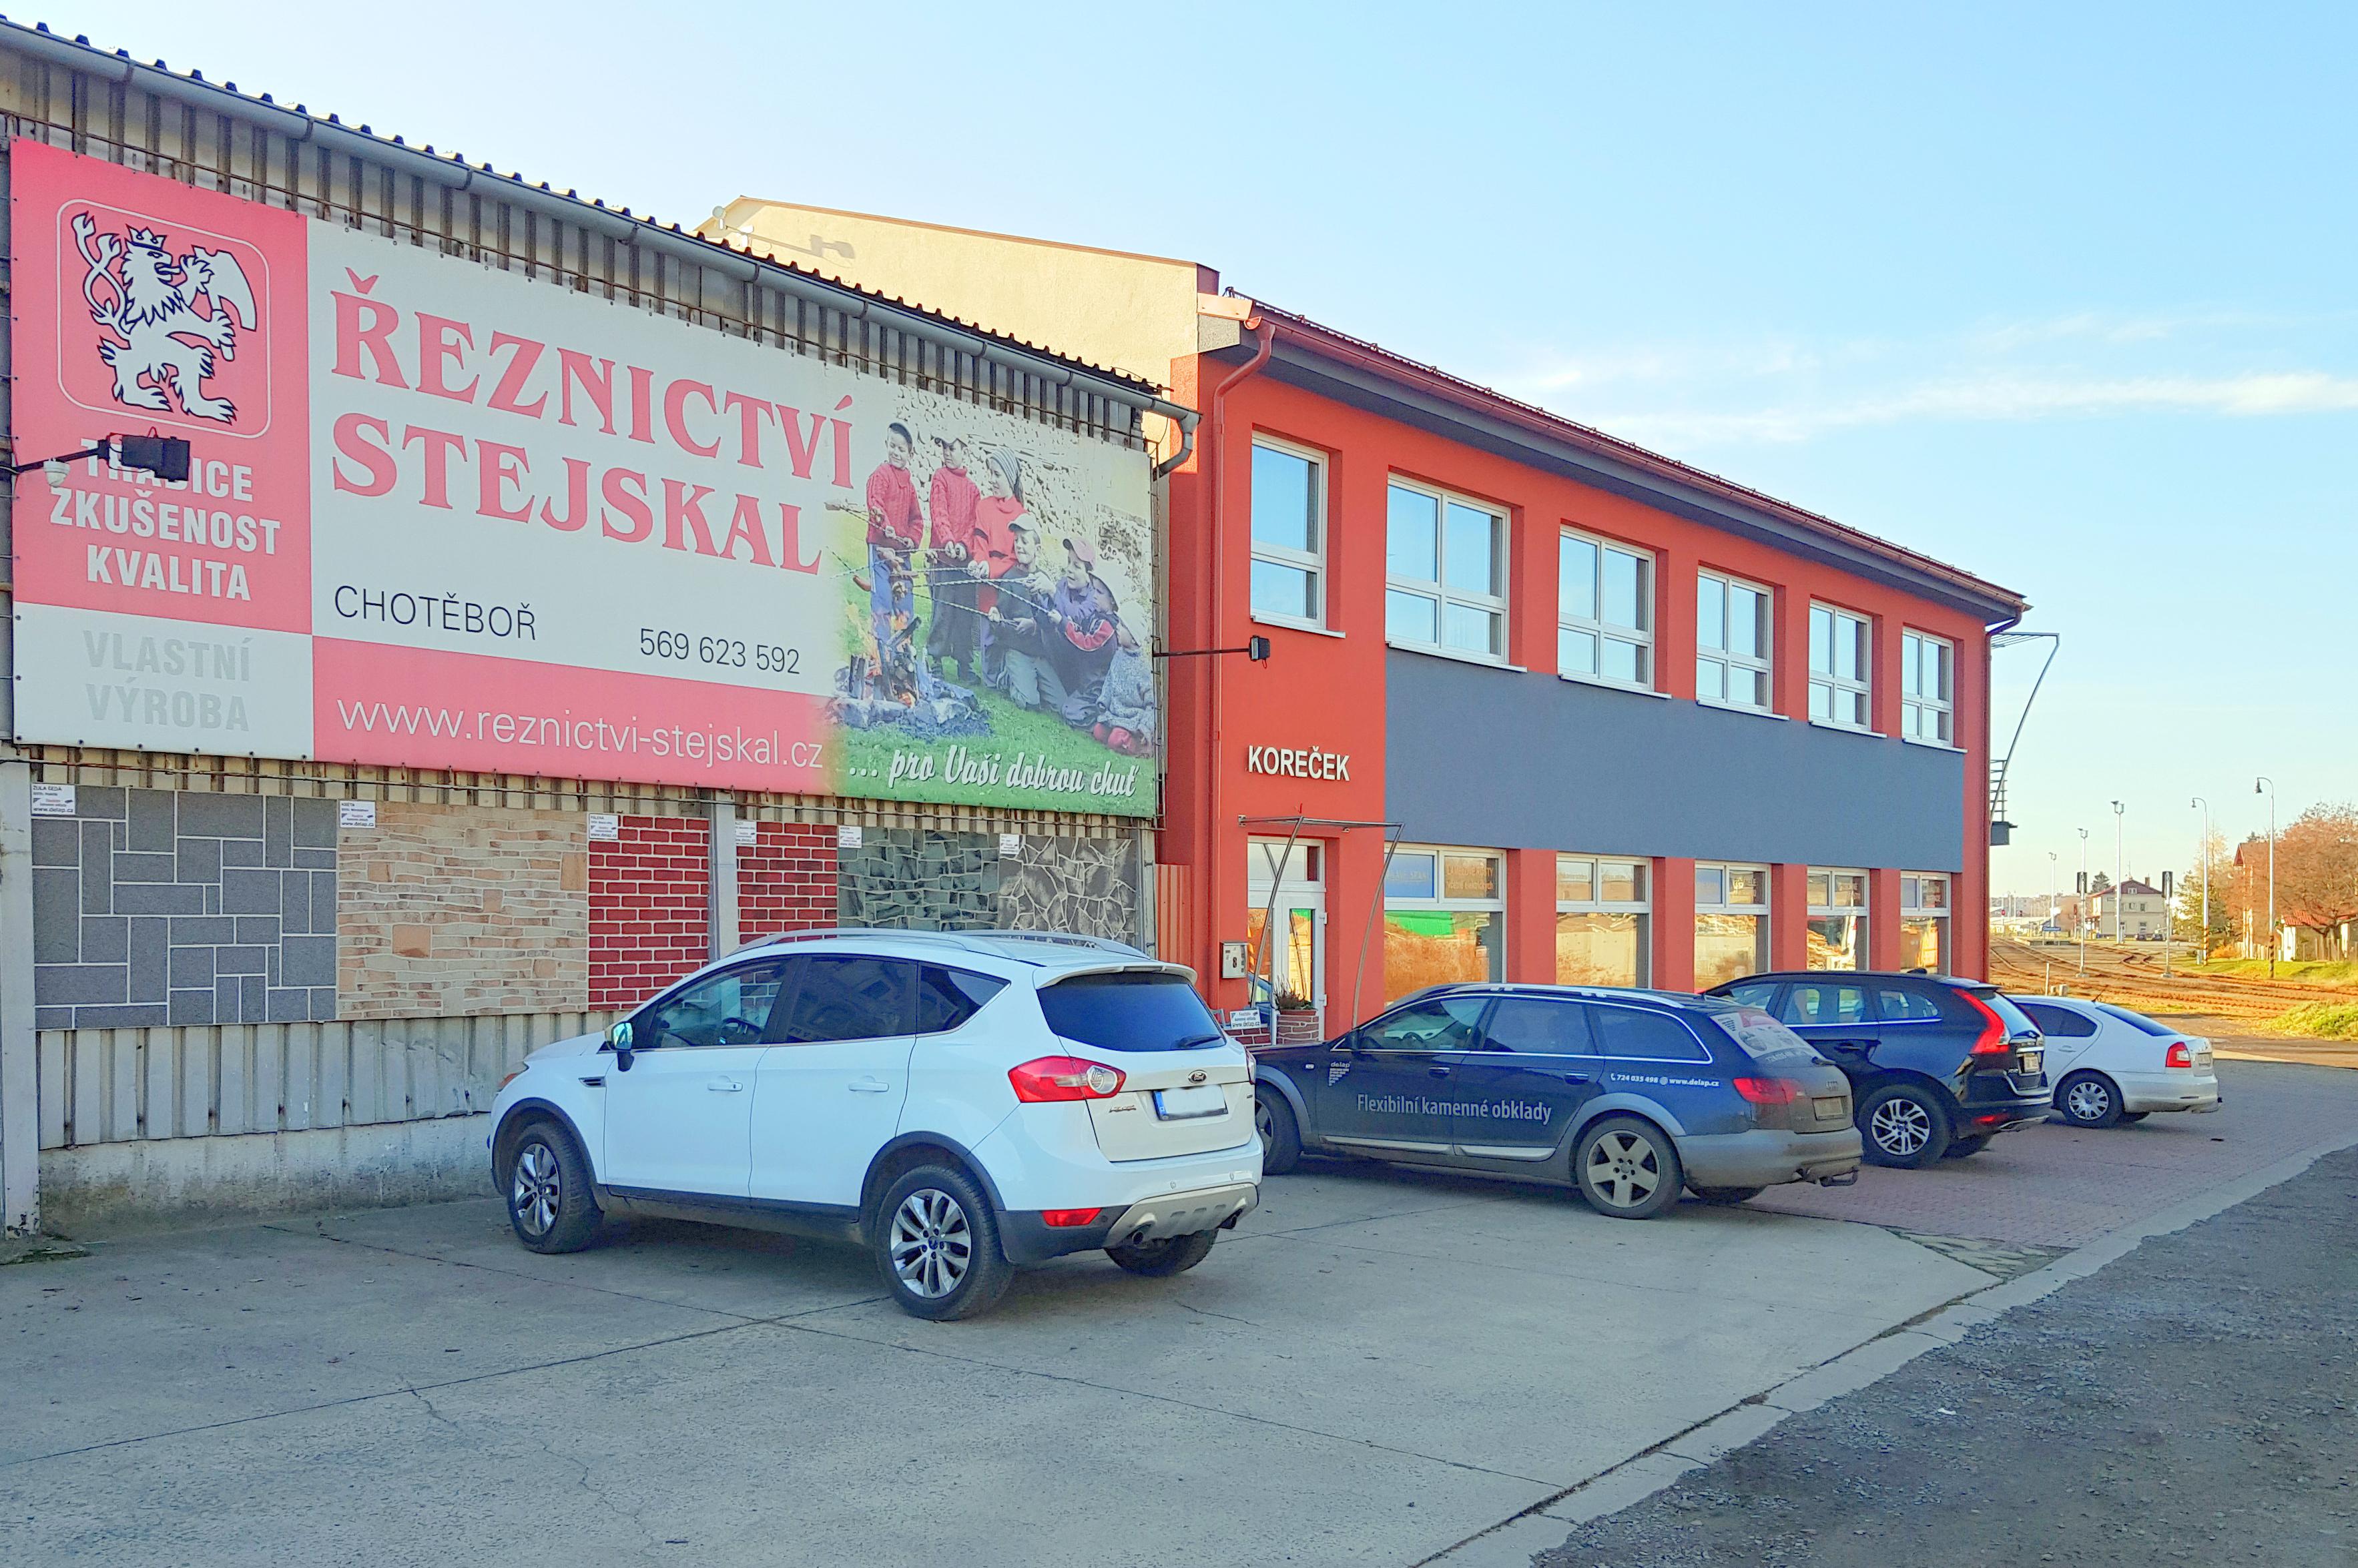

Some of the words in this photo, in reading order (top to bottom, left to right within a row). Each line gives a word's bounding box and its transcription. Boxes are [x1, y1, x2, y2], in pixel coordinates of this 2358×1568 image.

[330, 267, 854, 489] ŘEZNICTVÍ
[80, 438, 254, 502] TRICE
[332, 412, 822, 574] STEJSKAL
[50, 486, 282, 555] ZKUŠENOST
[87, 544, 251, 601] KVALITA
[334, 585, 536, 641] CHOTĚBOŘ
[83, 630, 254, 681] VLASTNÍ
[640, 628, 689, 660] 569
[699, 637, 746, 667] 623
[756, 644, 800, 675] 592
[85, 677, 249, 731] VÝROBA
[337, 699, 824, 769] www.reznictvi-stejskal.cz
[888, 749, 935, 788] pro
[944, 745, 1001, 786] Vaši
[1005, 752, 1087, 793] dobrou
[1089, 761, 1140, 797] chuť
[1249, 745, 1350, 781] KOREČEK
[1356, 1094, 1418, 1114] Flexibilní
[1422, 1096, 1488, 1118] kamenné
[1492, 1099, 1552, 1126] obklady
[1669, 1078, 1720, 1088] www.delap.cz
